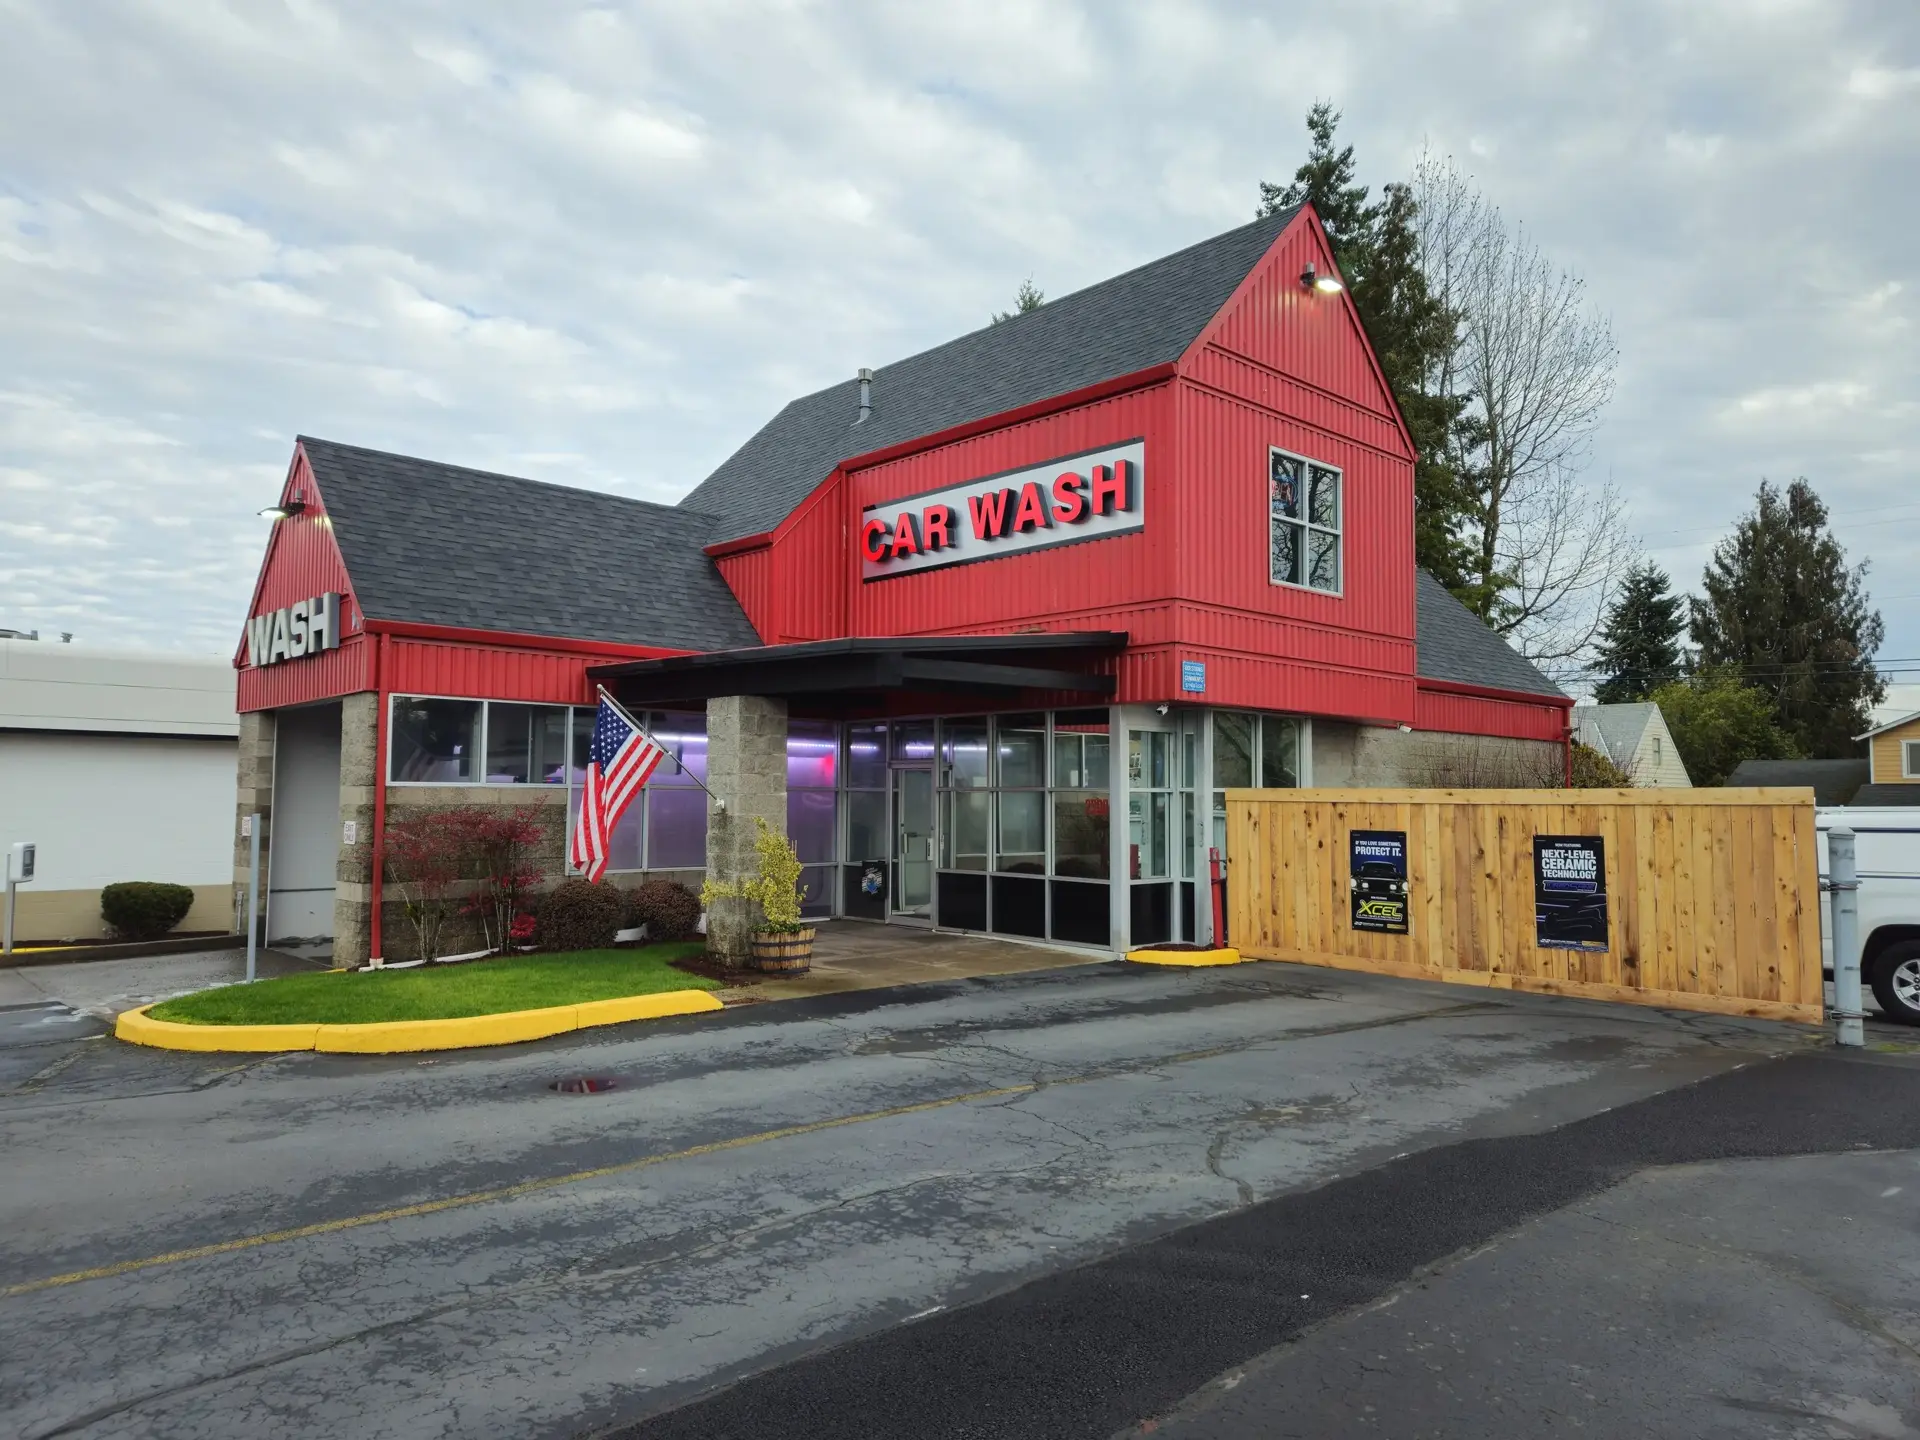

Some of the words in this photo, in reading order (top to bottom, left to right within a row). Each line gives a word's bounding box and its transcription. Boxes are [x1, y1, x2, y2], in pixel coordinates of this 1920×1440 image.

[862, 504, 952, 563] CAR
[967, 459, 1130, 540] WASH
[247, 592, 337, 667] WASH
[1355, 846, 1391, 856] PROTECT
[1392, 847, 1402, 857] IT.
[1542, 849, 1597, 860] NEXT-LEVEL
[1541, 858, 1597, 871] CERAMIC
[1542, 869, 1597, 880] TECHNOLOGY
[1358, 899, 1402, 917] XCEL
